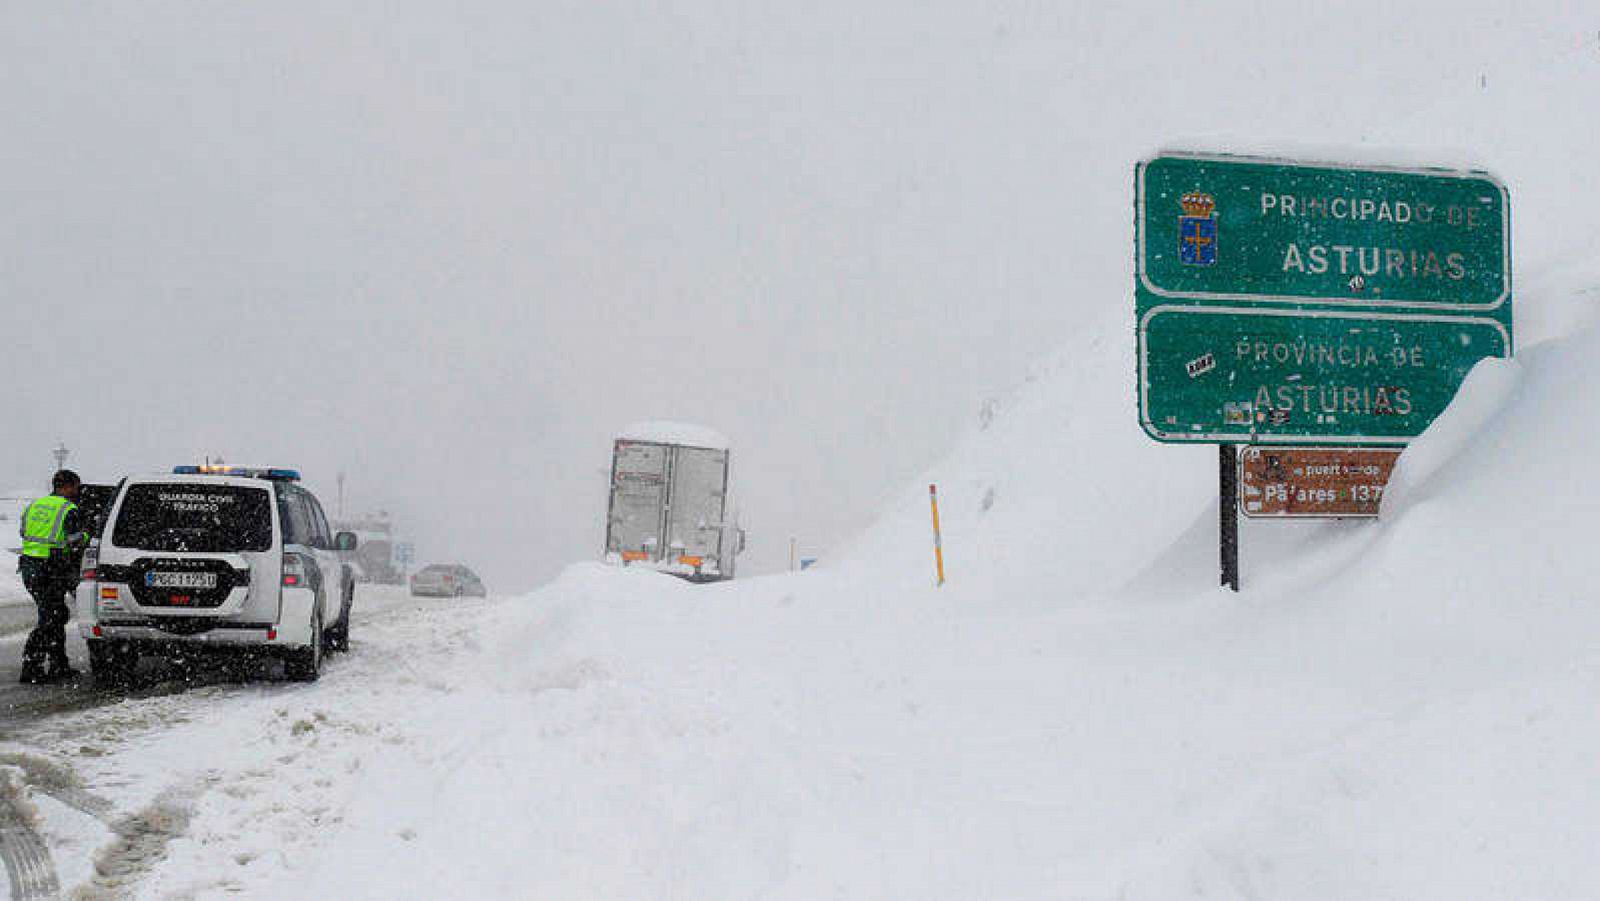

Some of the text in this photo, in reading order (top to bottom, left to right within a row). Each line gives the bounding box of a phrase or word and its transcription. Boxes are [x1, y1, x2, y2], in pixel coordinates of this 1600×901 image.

[1261, 193, 1481, 227] PRINCIPADO DE
[1283, 243, 1465, 280] ASTURIAS
[1237, 340, 1378, 367] PROVINCIA
[1393, 345, 1424, 367] DE
[1254, 384, 1412, 415] ASTURIAS
